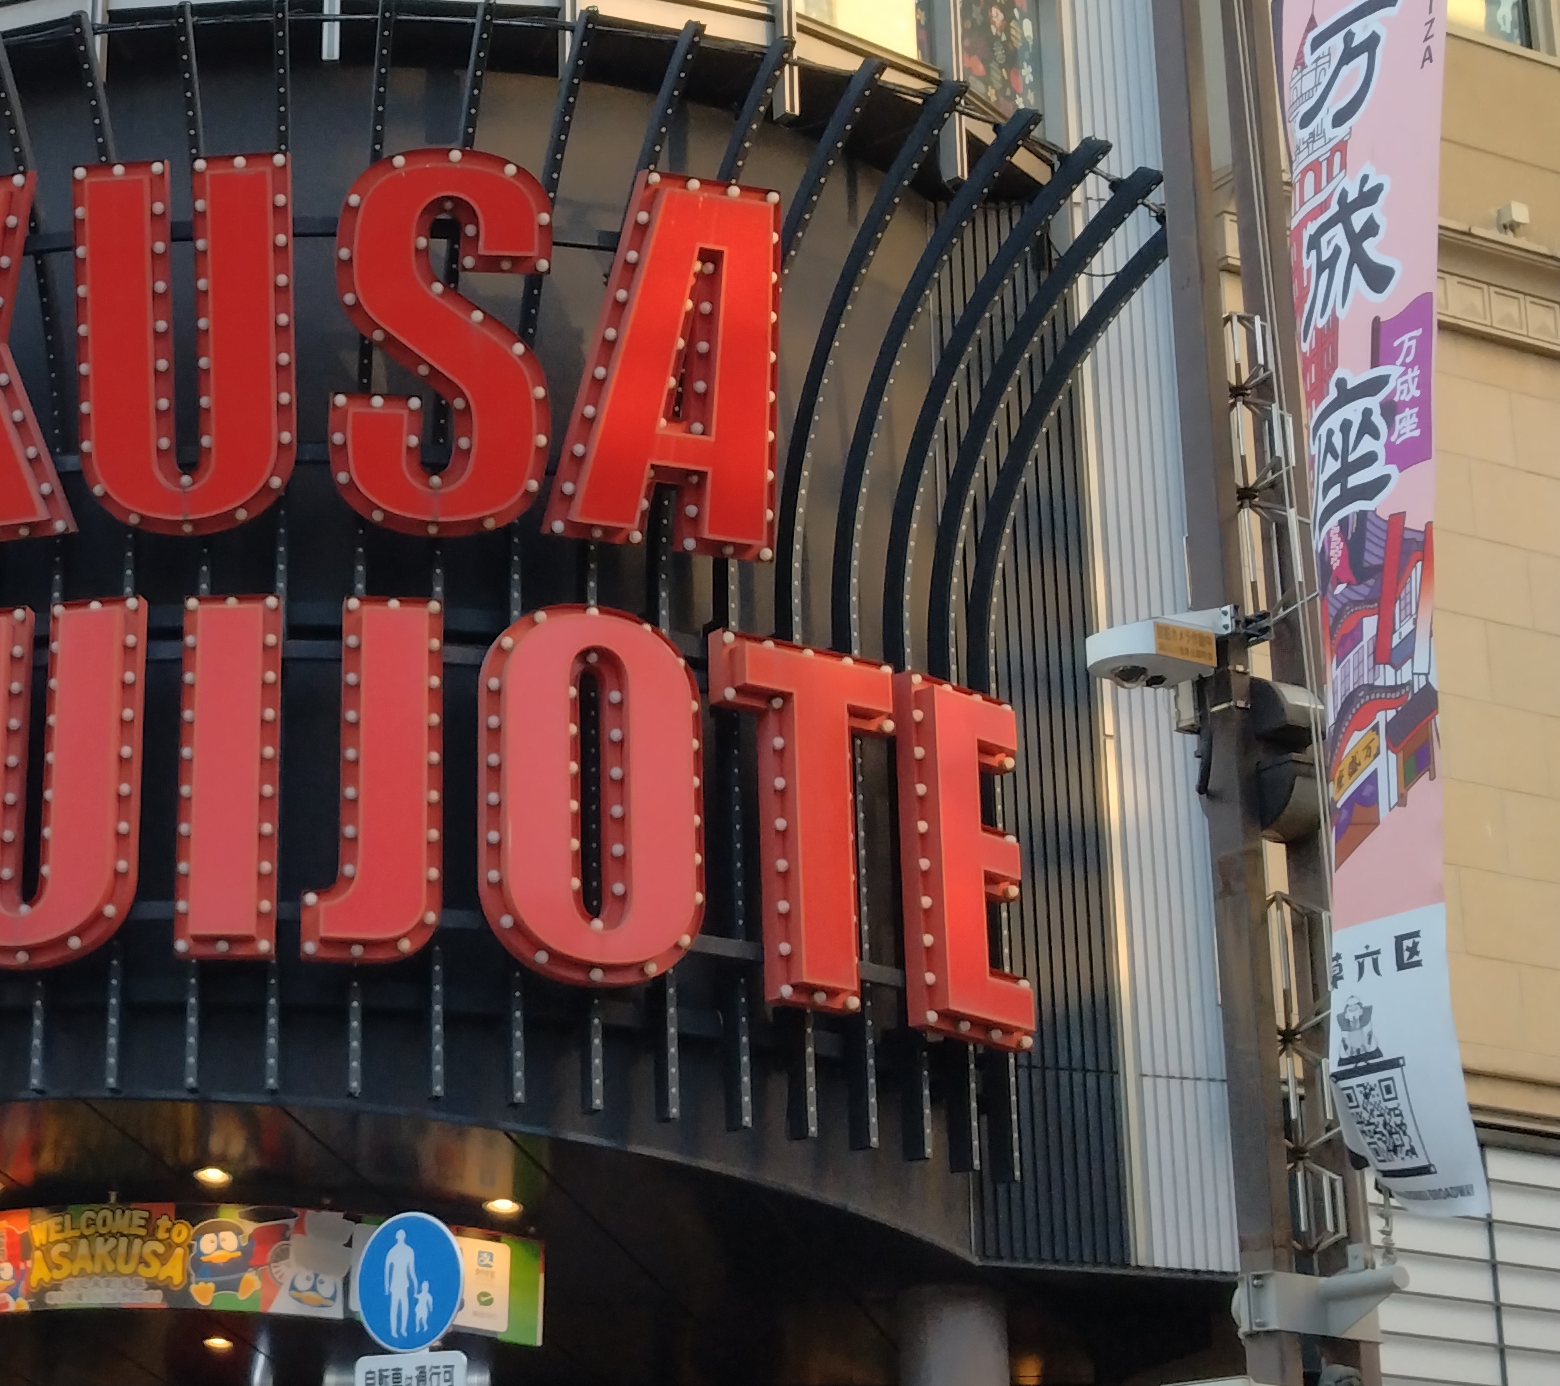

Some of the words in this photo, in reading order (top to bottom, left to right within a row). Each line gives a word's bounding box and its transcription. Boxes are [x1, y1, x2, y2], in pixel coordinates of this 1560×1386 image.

[1389, 327, 1423, 446] 万成座
[30, 1208, 150, 1248] WELCOME
[156, 1215, 190, 1244] to
[29, 1236, 186, 1288] ASAKUSA
